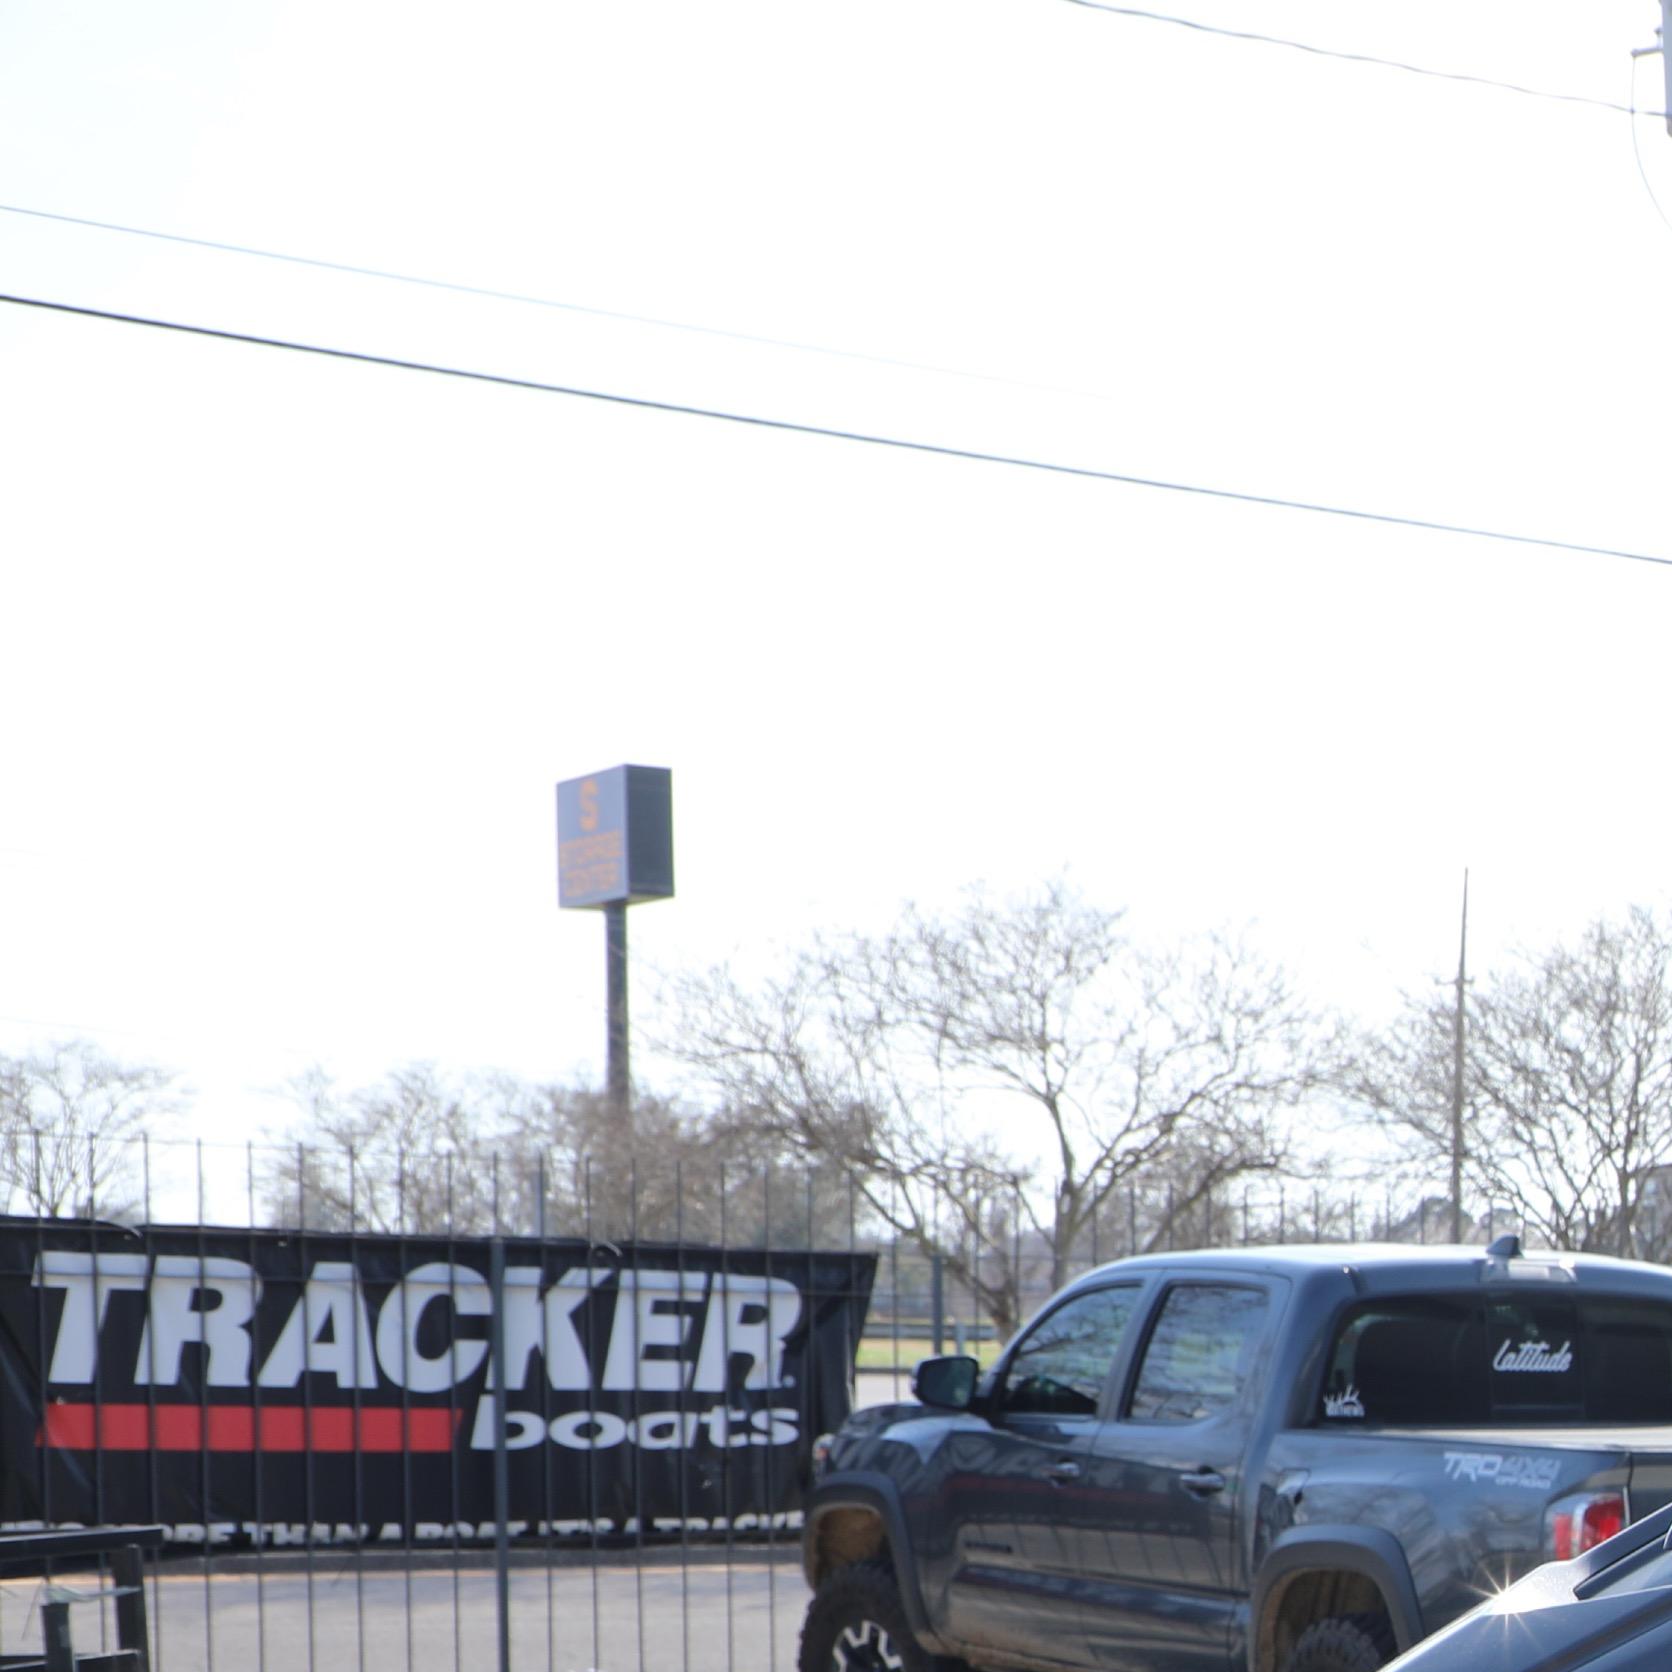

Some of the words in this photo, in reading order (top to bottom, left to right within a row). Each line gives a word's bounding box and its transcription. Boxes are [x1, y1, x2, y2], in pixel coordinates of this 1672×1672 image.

[33, 1250, 801, 1393] TRACKER
[1492, 1339, 1573, 1372] Latitude
[470, 1395, 800, 1451] boats
[1444, 1452, 1503, 1482] TRD
